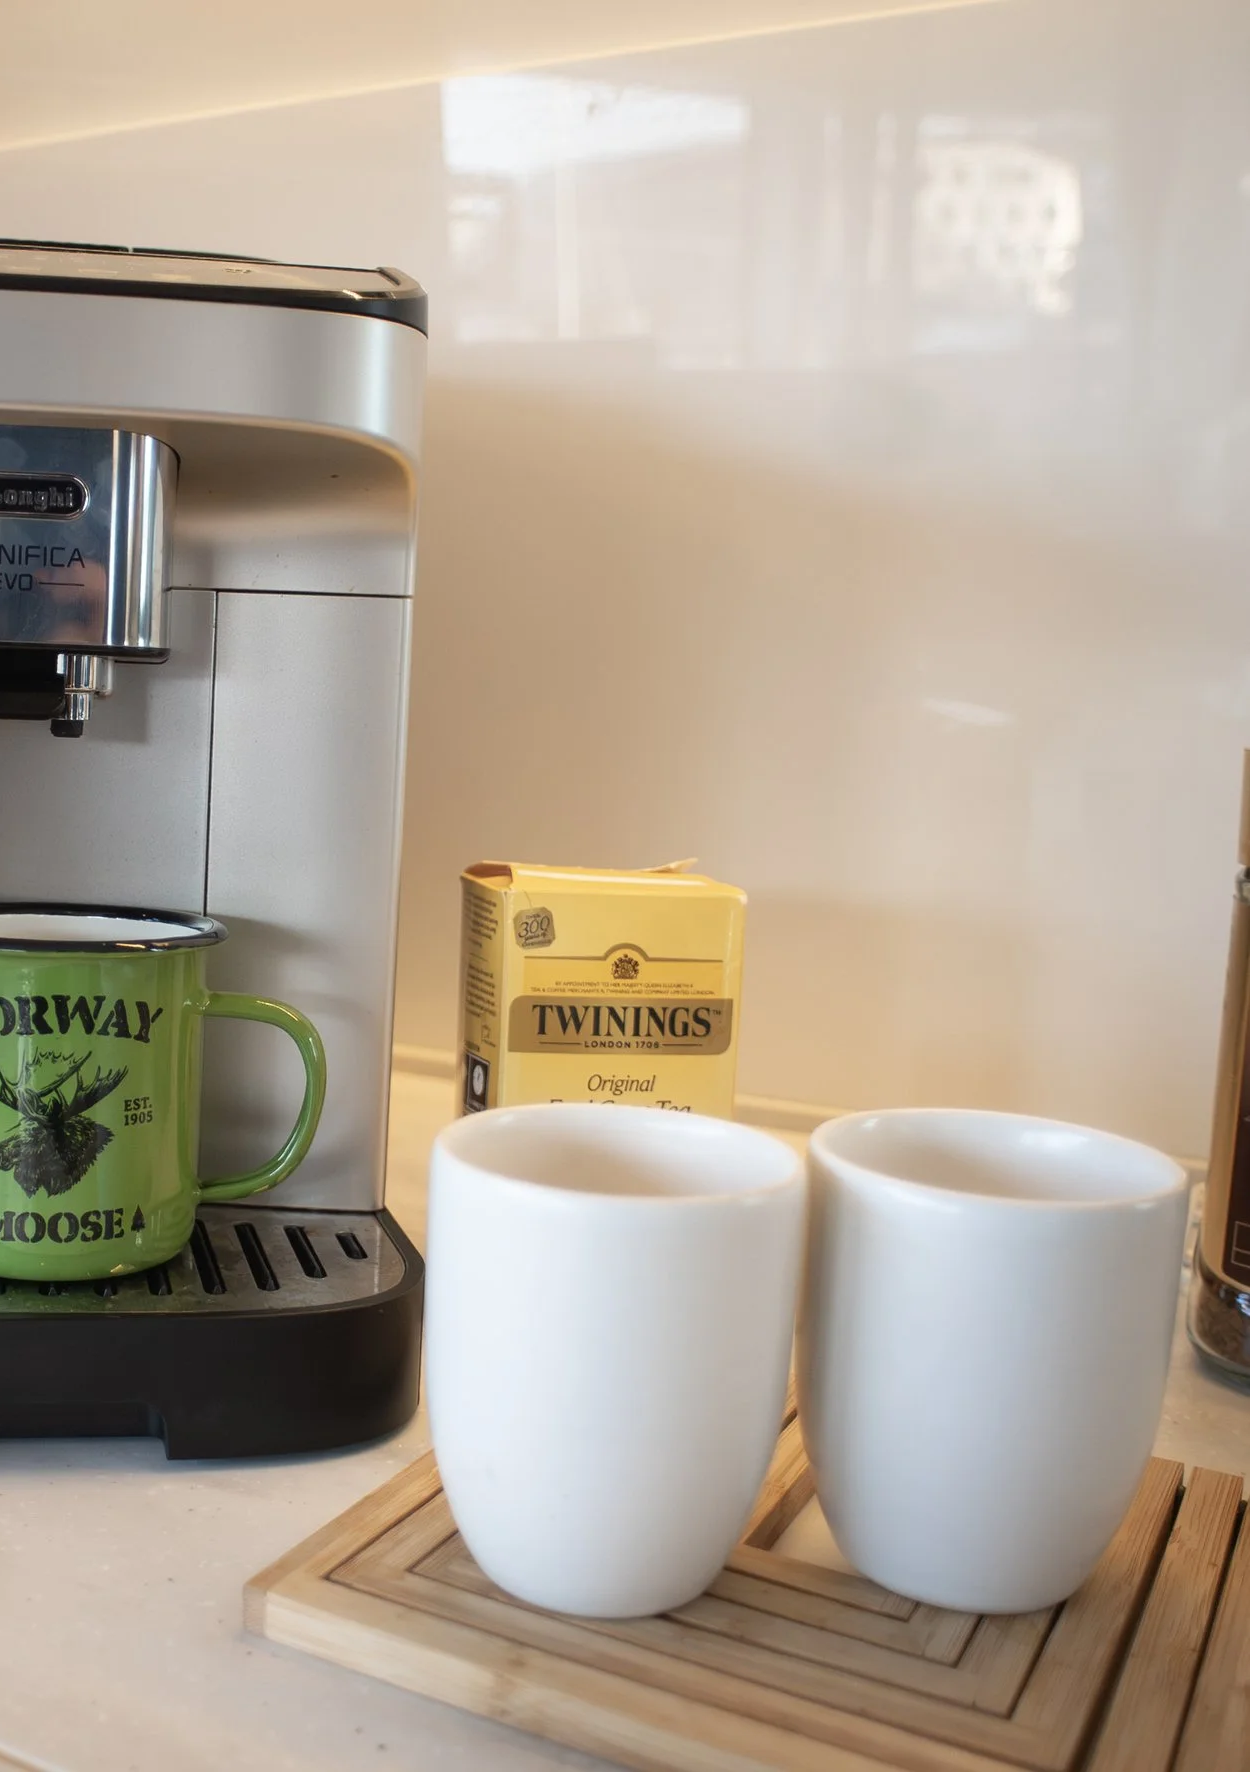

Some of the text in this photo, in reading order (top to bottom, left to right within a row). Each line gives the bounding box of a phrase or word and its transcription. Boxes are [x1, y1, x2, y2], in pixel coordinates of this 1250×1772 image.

[517, 915, 551, 938] 300
[531, 1004, 712, 1038] TWININGS
[584, 1040, 631, 1049] LONDON
[587, 1073, 657, 1096] Original
[123, 1096, 153, 1112] EST.
[123, 1110, 154, 1127] 1905
